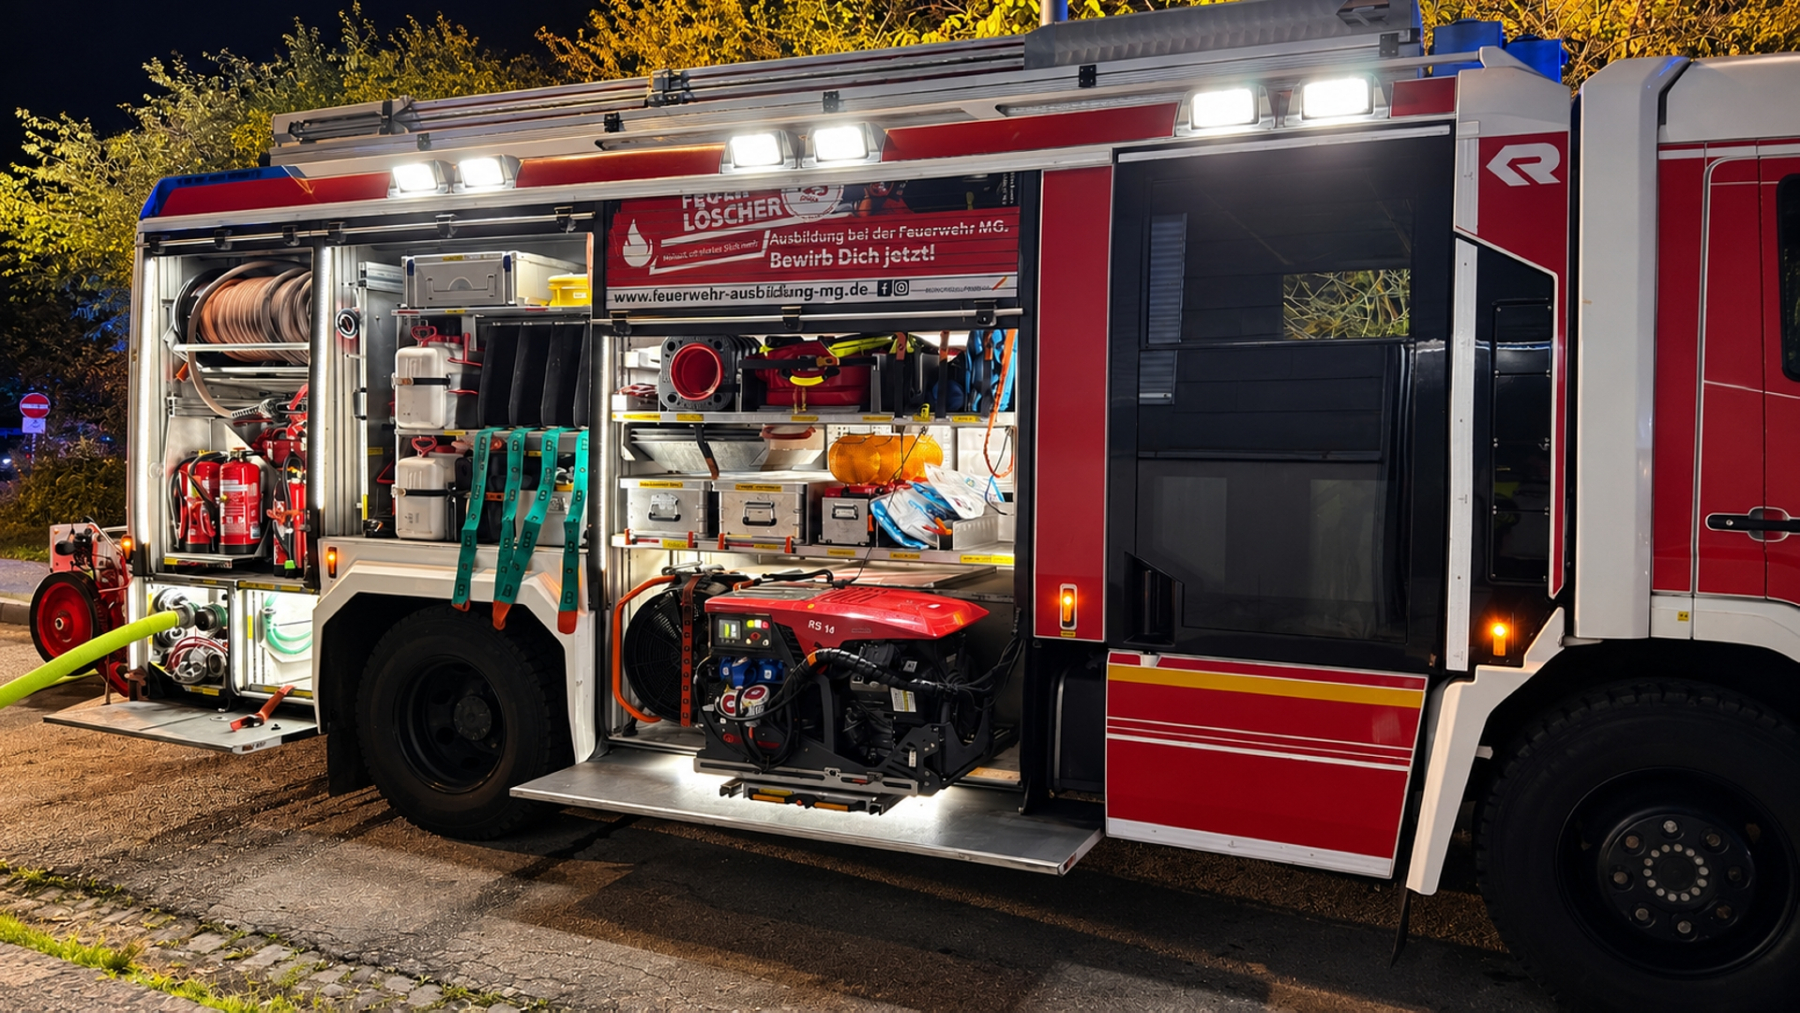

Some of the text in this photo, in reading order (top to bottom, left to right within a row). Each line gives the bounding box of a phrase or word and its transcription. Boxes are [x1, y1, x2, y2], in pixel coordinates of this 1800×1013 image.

[683, 197, 782, 231] LÖSCHER
[769, 219, 1009, 246] Ausbildung bei der Feuerwehr MG.
[770, 249, 833, 269] Bewirb
[838, 246, 879, 266] Dich
[882, 243, 936, 269] jetzt!
[808, 619, 822, 631] RS
